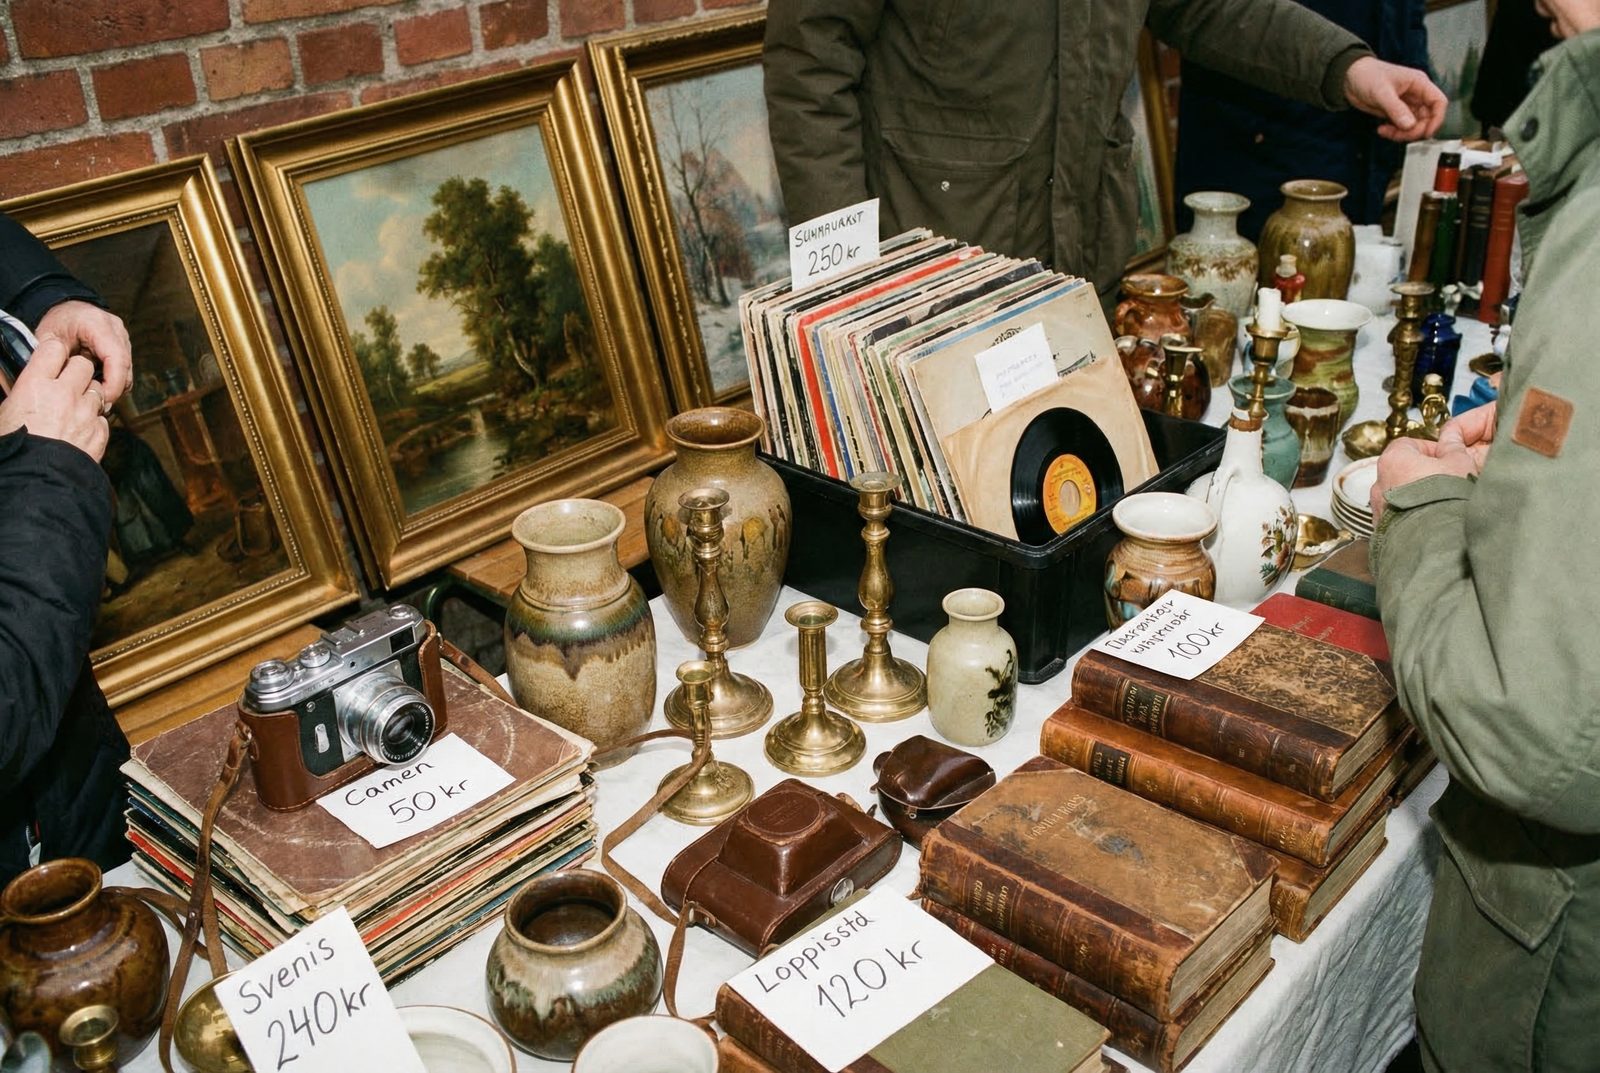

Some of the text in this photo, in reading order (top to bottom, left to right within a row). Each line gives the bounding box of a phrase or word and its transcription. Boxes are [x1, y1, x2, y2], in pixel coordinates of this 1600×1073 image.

[808, 243, 861, 276] 250 kr
[344, 760, 436, 806] Camen
[388, 778, 469, 824] 50 kr
[238, 937, 335, 1015] Svenis
[816, 939, 924, 1018] 120 kr
